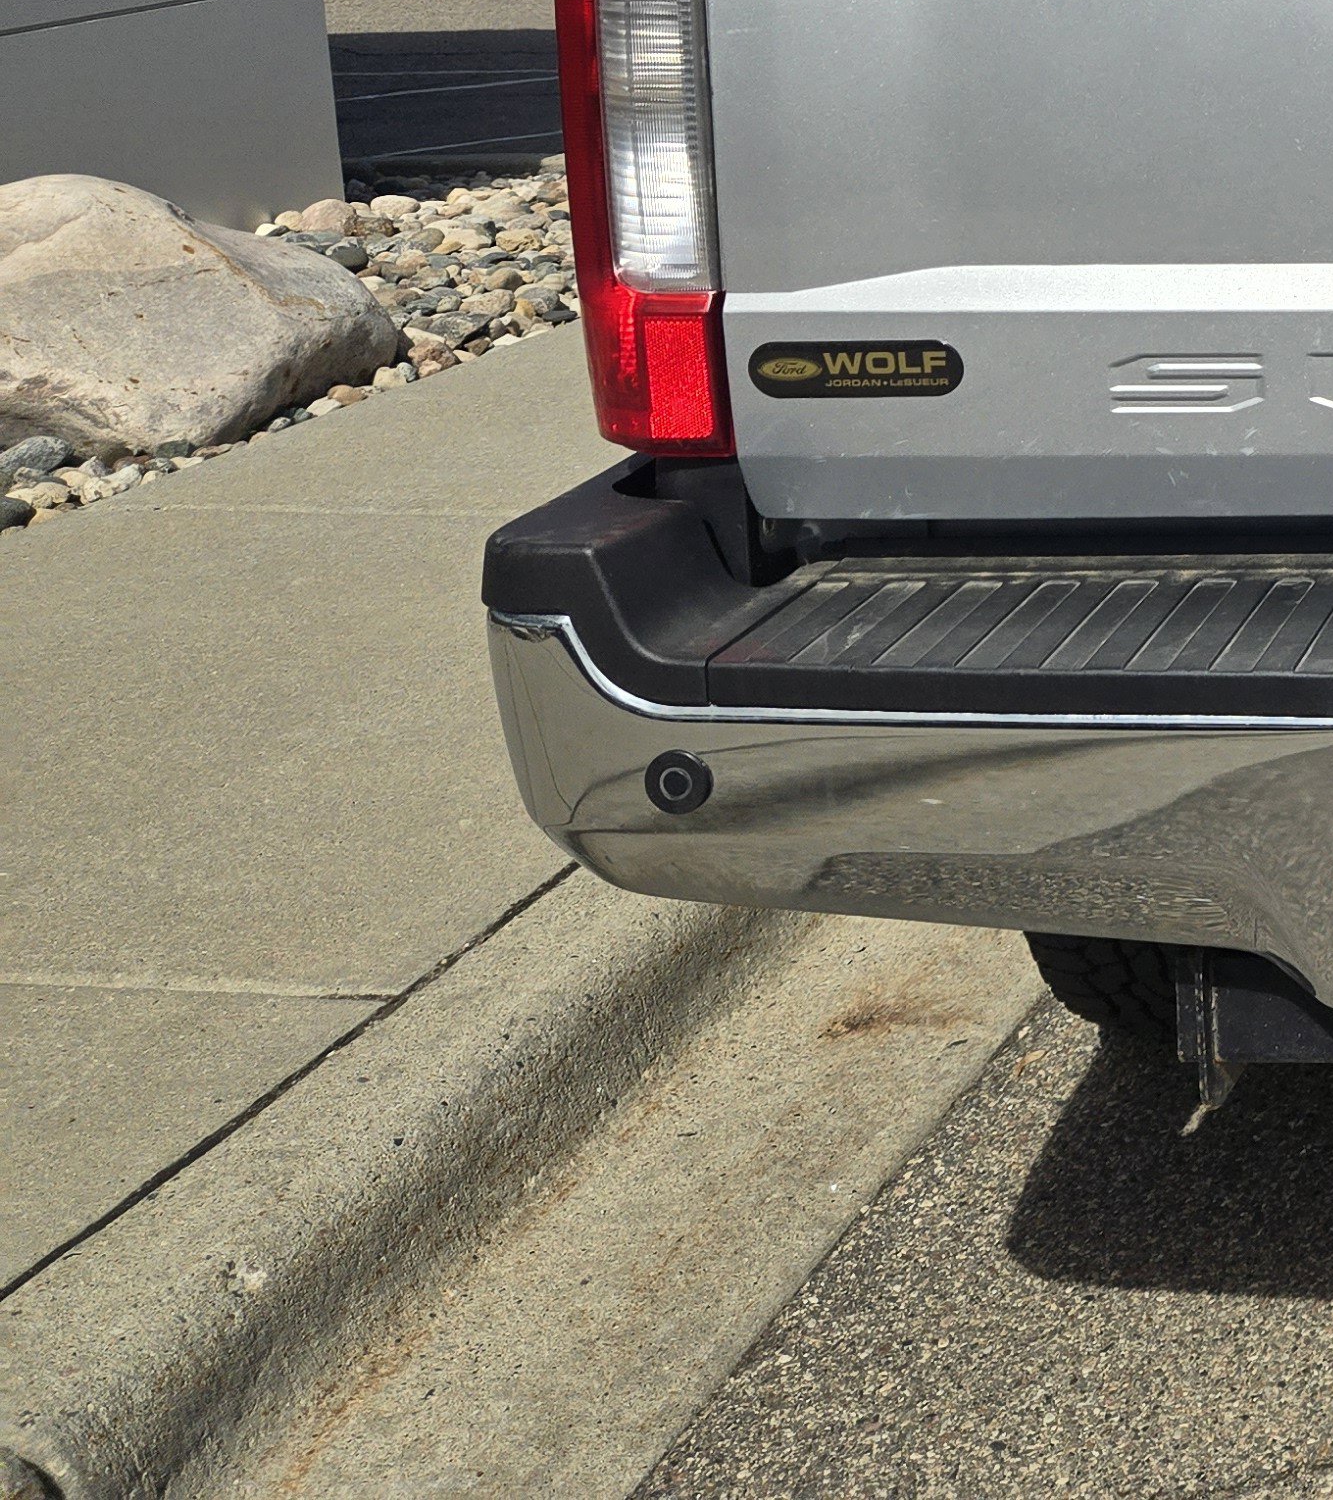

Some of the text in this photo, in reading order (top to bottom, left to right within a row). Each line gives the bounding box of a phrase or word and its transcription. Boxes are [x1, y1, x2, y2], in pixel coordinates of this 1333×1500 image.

[772, 361, 807, 375] Ford
[823, 351, 946, 374] WOLF
[825, 379, 881, 387] JORDAN
